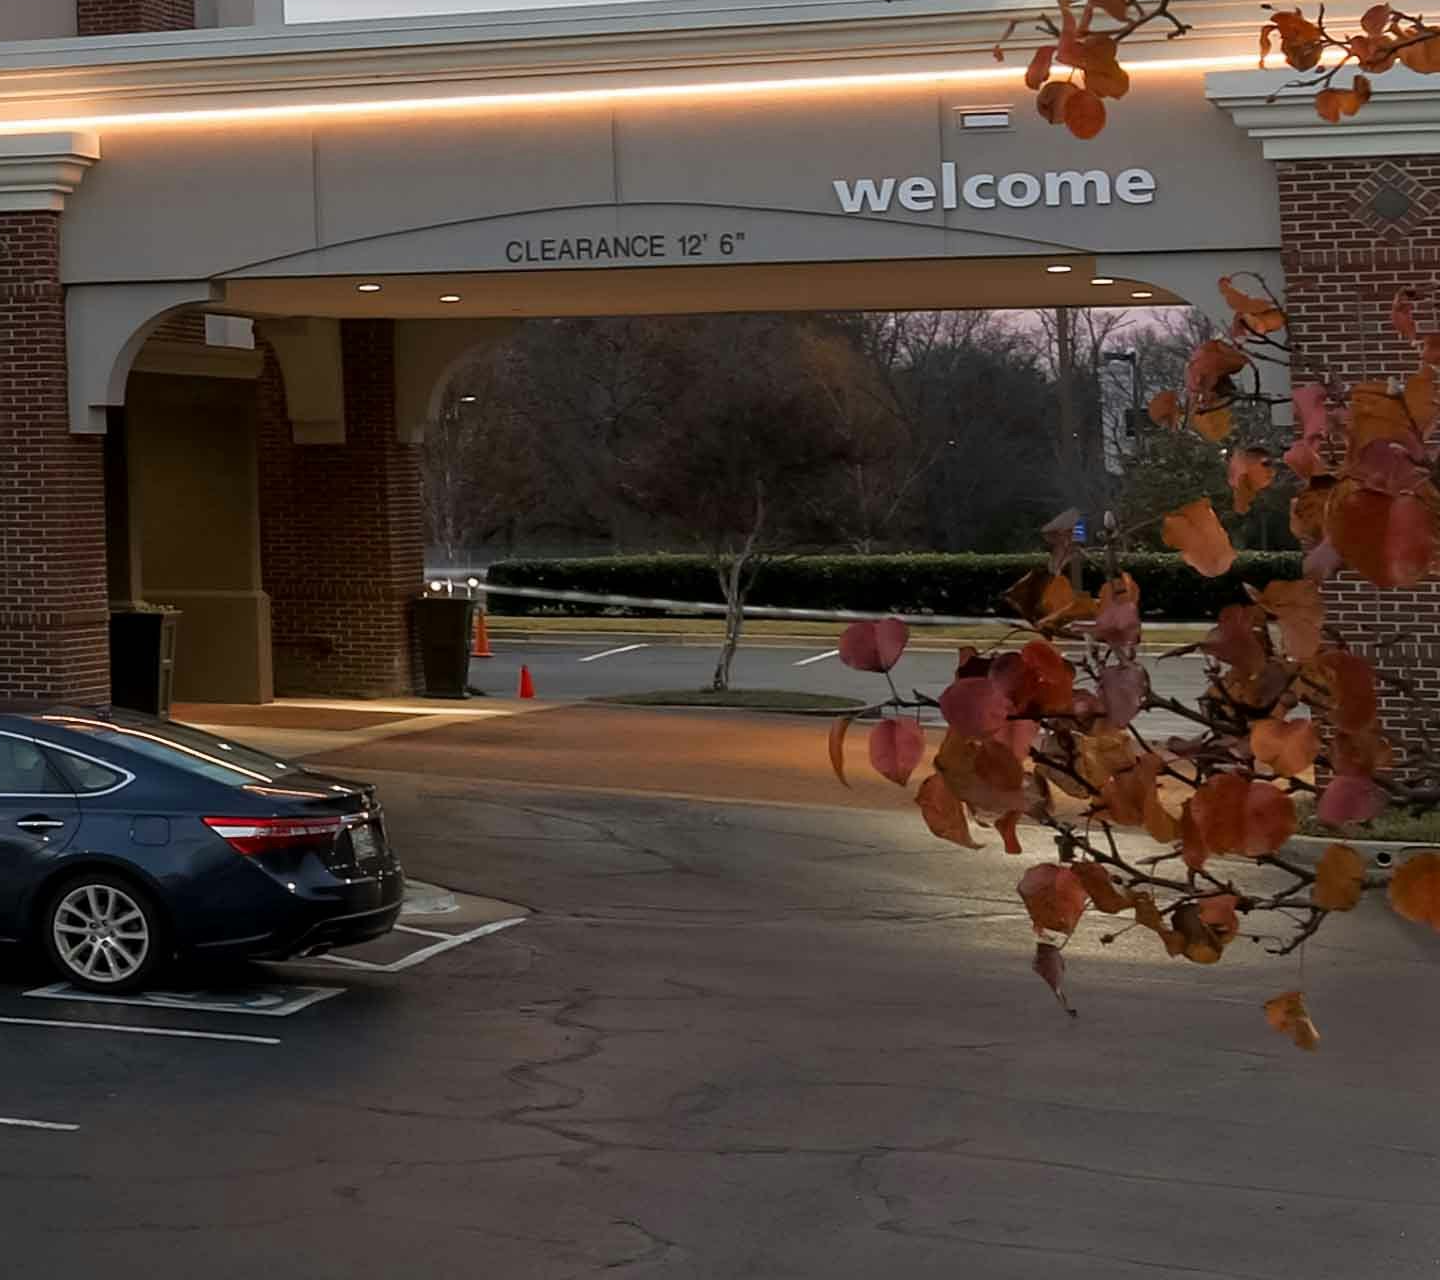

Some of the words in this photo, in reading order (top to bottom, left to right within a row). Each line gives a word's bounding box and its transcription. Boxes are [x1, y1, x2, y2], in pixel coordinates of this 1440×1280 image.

[832, 160, 1157, 214] welcome
[505, 235, 666, 264] CLEARANCE
[677, 233, 708, 257] 12'
